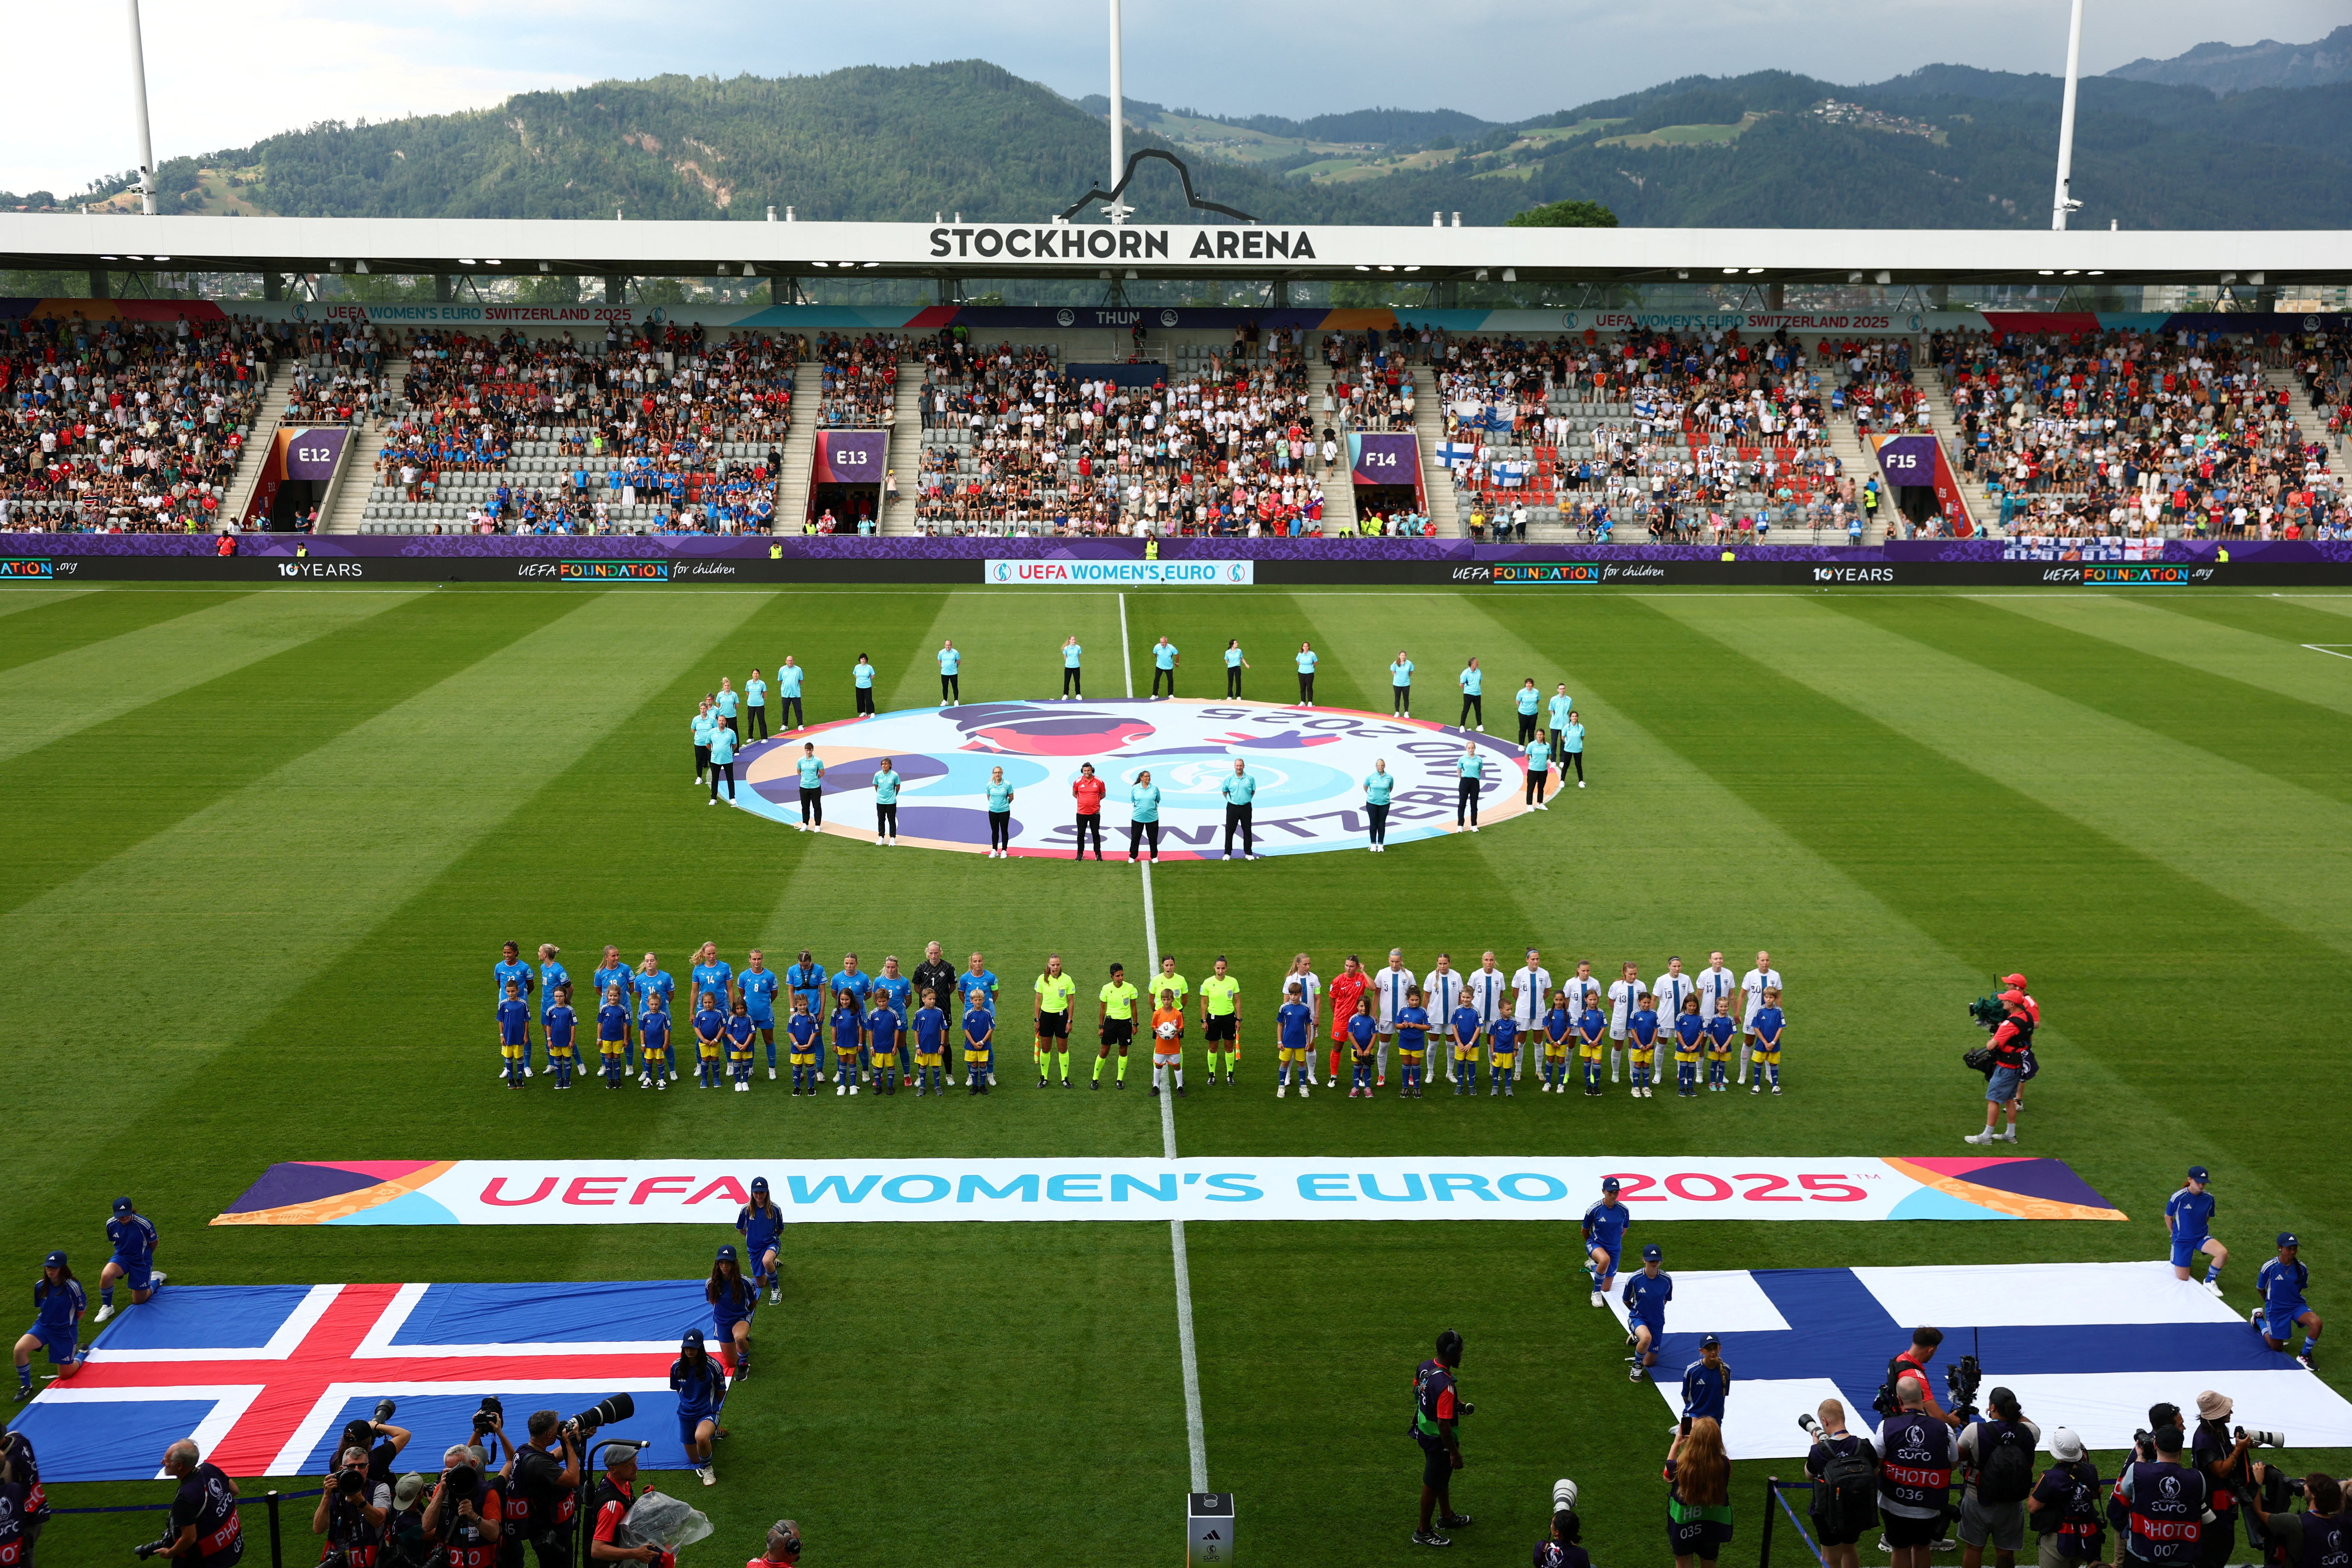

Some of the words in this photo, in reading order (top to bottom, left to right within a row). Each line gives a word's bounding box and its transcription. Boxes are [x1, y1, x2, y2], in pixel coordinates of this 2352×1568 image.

[930, 229, 1168, 259] STOCKHORN
[1190, 231, 1316, 259] ARENA
[327, 307, 367, 319] UEFA
[369, 307, 437, 319] WOMEN'S
[442, 308, 481, 319] EURO
[485, 308, 590, 320] SWITZERLAND
[594, 309, 632, 321] 2025
[1096, 312, 1140, 324] THUN
[1596, 315, 1633, 326] UEFA
[1637, 315, 1702, 327] WOMEN'S
[1707, 315, 1744, 327] EURO
[1748, 316, 1849, 328] SWITZERLAND
[1853, 316, 1889, 328] 2025
[299, 448, 330, 461] E12
[837, 451, 867, 464] E13
[1366, 453, 1397, 466] F14
[1886, 454, 1916, 468] F15
[278, 563, 299, 576] 10
[300, 564, 362, 576] YEARS
[518, 564, 557, 576] UEFA
[560, 563, 668, 577] FOUNDATION
[673, 564, 689, 578] for
[693, 563, 735, 574] children
[1019, 565, 1068, 579] UEFA
[1071, 565, 1159, 580] WOMEN'S
[1165, 565, 1216, 580] EURO
[1452, 567, 1490, 580] UEFA
[1494, 566, 1599, 580] FOUNDATION
[1603, 564, 1619, 580] for
[1622, 564, 1664, 576] children
[1834, 568, 1893, 581] YEARS
[2043, 568, 2081, 581] UEFA
[2083, 568, 2189, 581] FOUNDATION
[2192, 568, 2214, 581] .org
[1197, 708, 1417, 738] 2025
[543, 976, 547, 985] 20
[706, 975, 715, 984] 14
[931, 977, 935, 986] 1
[754, 984, 759, 992] 8
[1385, 984, 1388, 992] 3
[1436, 987, 1439, 995] 4
[1477, 985, 1482, 993] 5
[1706, 985, 1714, 993] 17
[1751, 985, 1761, 993] 20
[1574, 993, 1578, 1001] 9
[1619, 995, 1627, 1003] 13
[1665, 991, 1672, 999] 15
[480, 1176, 751, 1206] UEFA
[787, 1174, 1264, 1203] WOMEN'S
[1296, 1173, 1568, 1202] EURO
[1599, 1172, 1868, 1202] 2025
[1887, 1465, 1940, 1485] PHOTO
[1896, 1487, 1924, 1501] 036
[1683, 1506, 1702, 1521] HB
[1680, 1524, 1702, 1539] 035
[2143, 1519, 2197, 1539] PHOTO
[2154, 1543, 2179, 1557] 007
